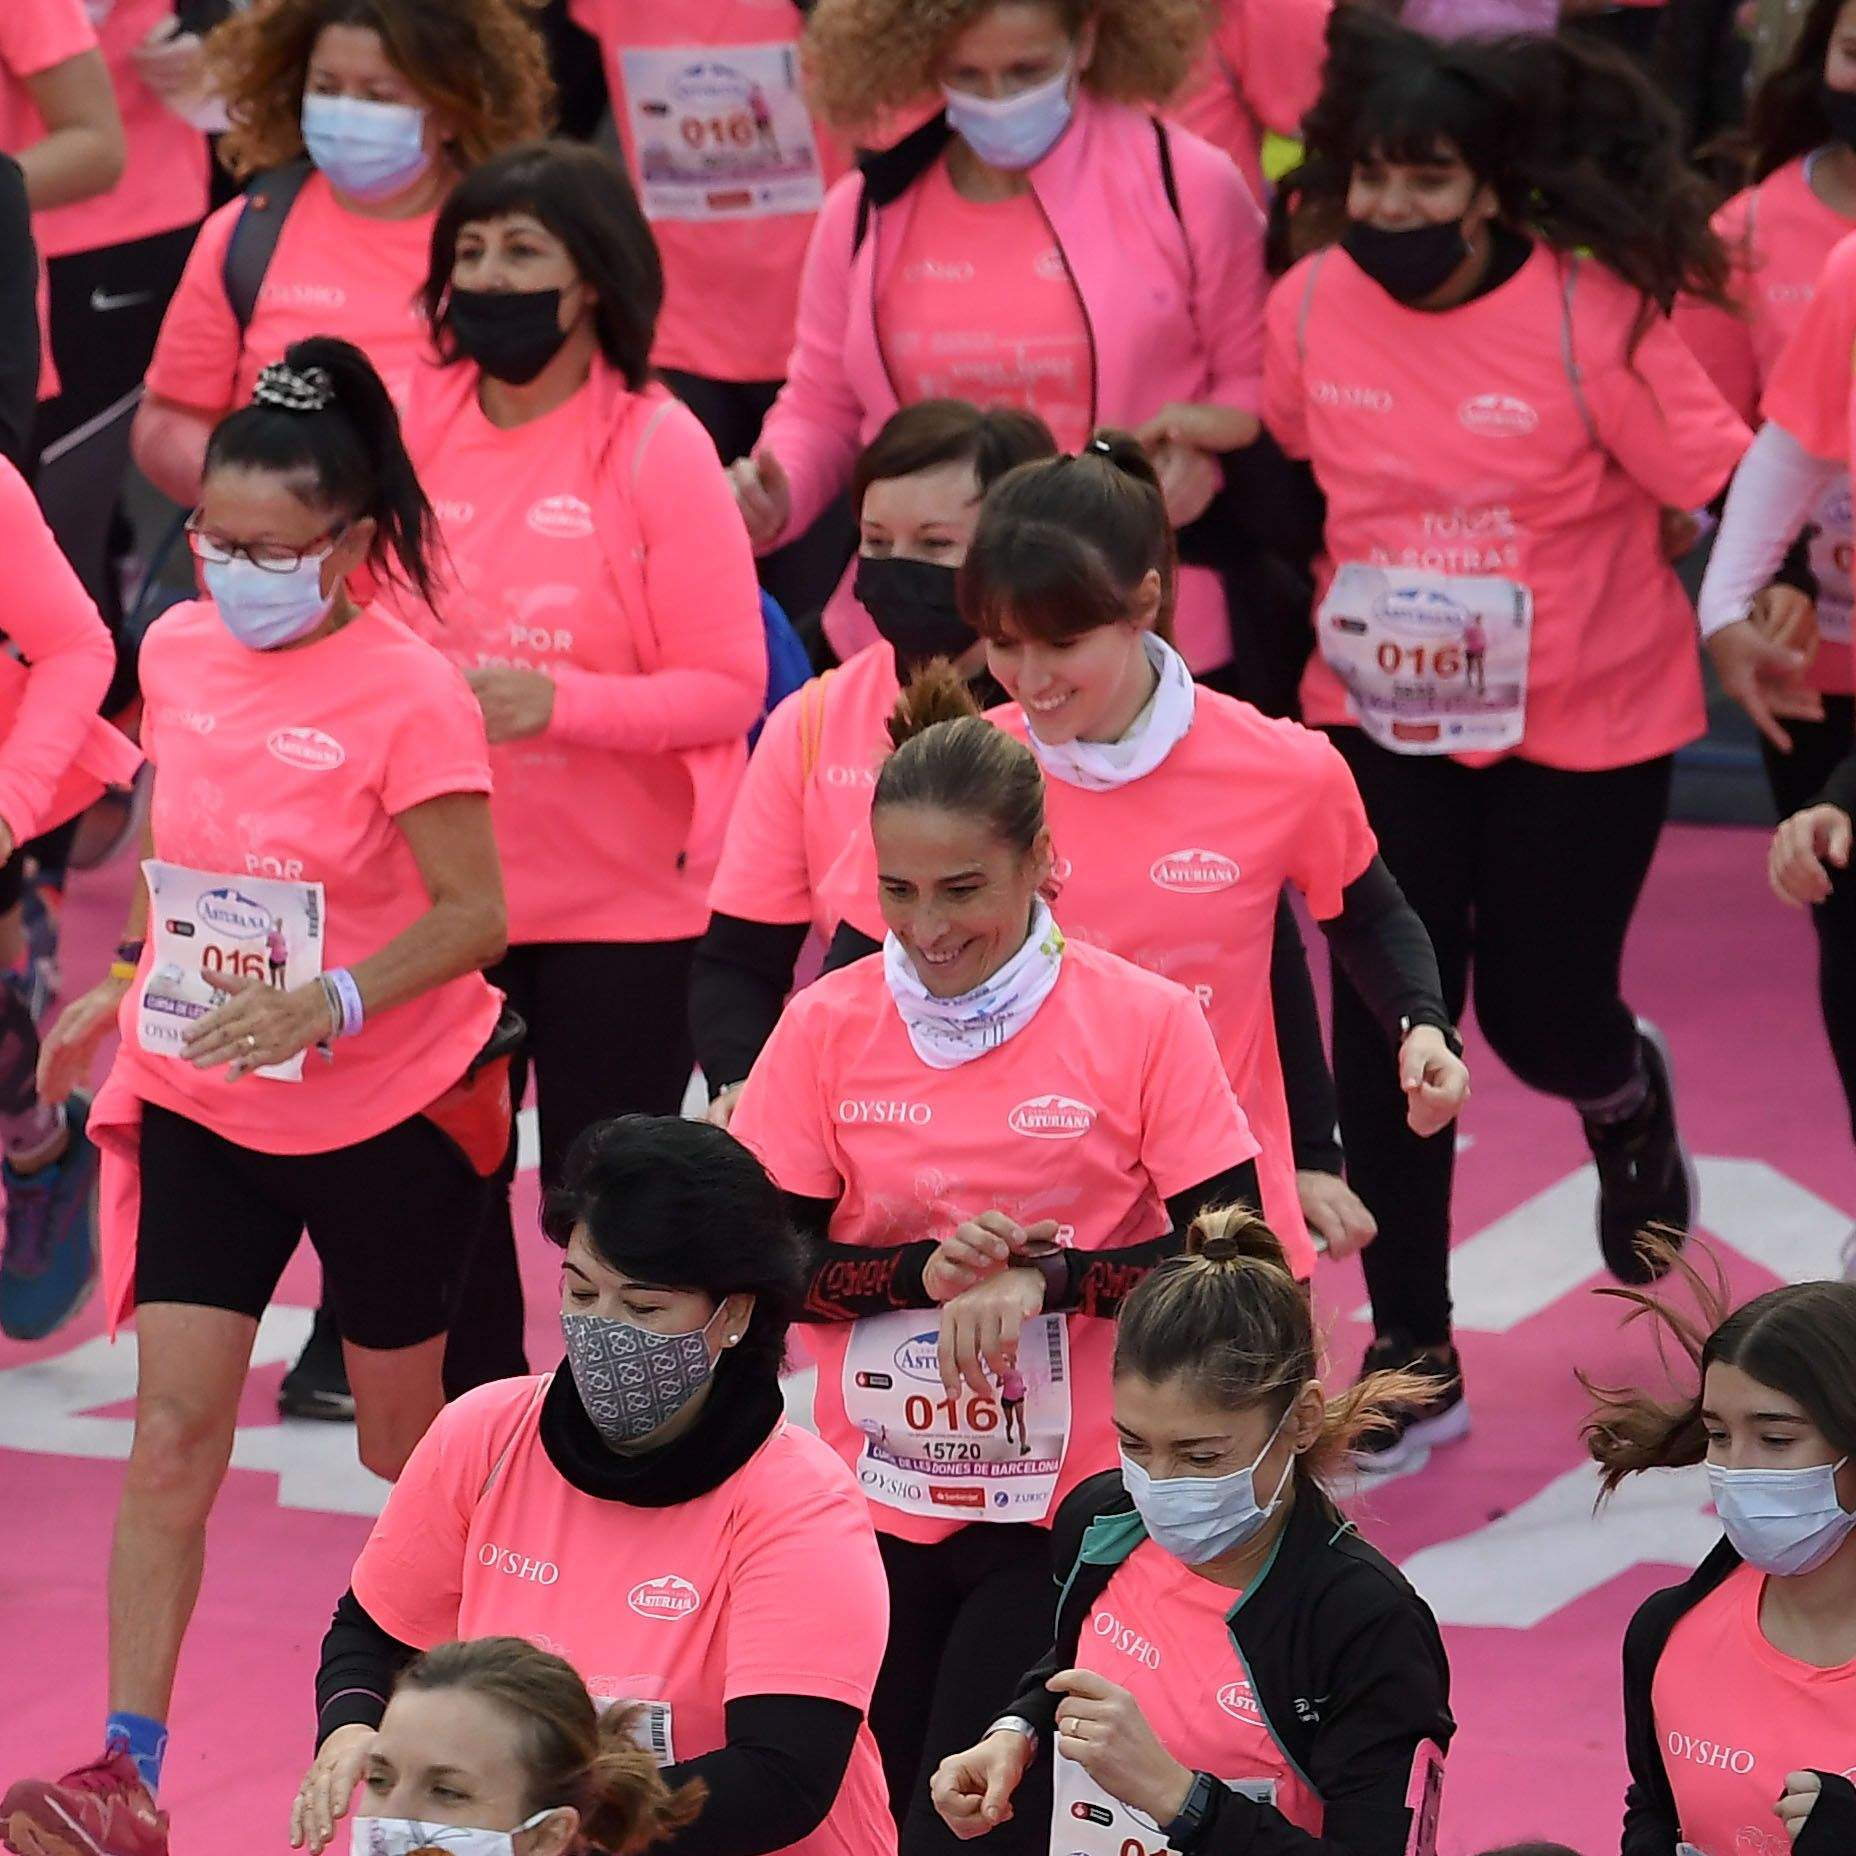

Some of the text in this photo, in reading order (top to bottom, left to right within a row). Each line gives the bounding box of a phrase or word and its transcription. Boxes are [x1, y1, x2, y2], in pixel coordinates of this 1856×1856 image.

[1376, 642, 1460, 680] 016
[827, 766, 880, 786] OYS
[1156, 863, 1234, 884] ASTURIANA
[838, 1100, 932, 1126] OYSHO
[1015, 1110, 1091, 1130] ASTURIANA
[904, 1395, 999, 1433] 016
[922, 1442, 981, 1460] 15720
[931, 1461, 972, 1476] DONES
[973, 1463, 989, 1477] DE
[991, 1460, 1059, 1477] BARCELONA
[861, 1470, 922, 1501] OYSHO
[478, 1542, 560, 1585] OYSHO
[1092, 1611, 1162, 1671] OYSHO
[1667, 1731, 1756, 1776] OYSHO
